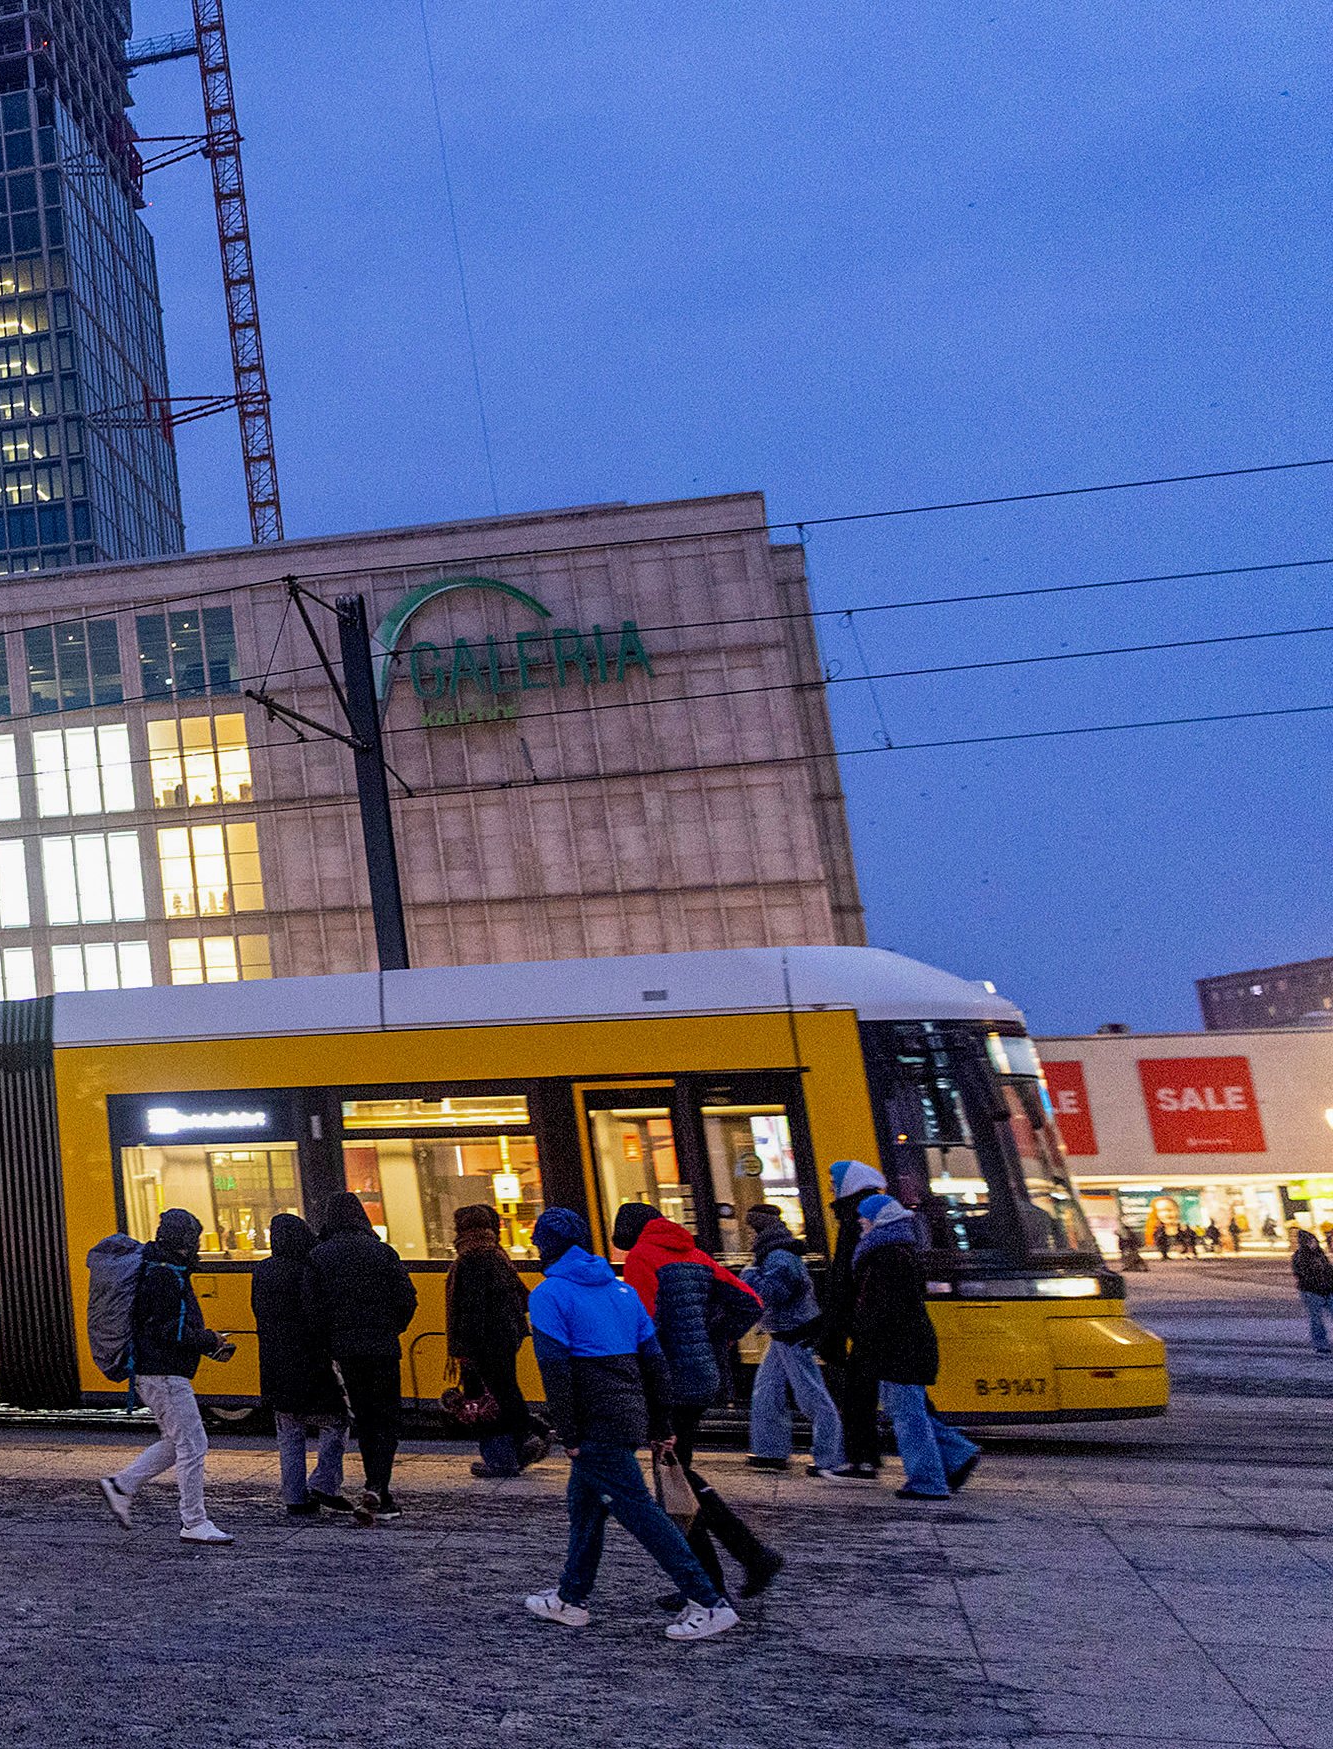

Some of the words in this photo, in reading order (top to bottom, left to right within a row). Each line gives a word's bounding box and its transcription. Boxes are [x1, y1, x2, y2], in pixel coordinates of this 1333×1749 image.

[410, 620, 654, 700] GALERIA
[1155, 1086, 1248, 1112] SALE
[975, 1378, 1046, 1396] B-9147
